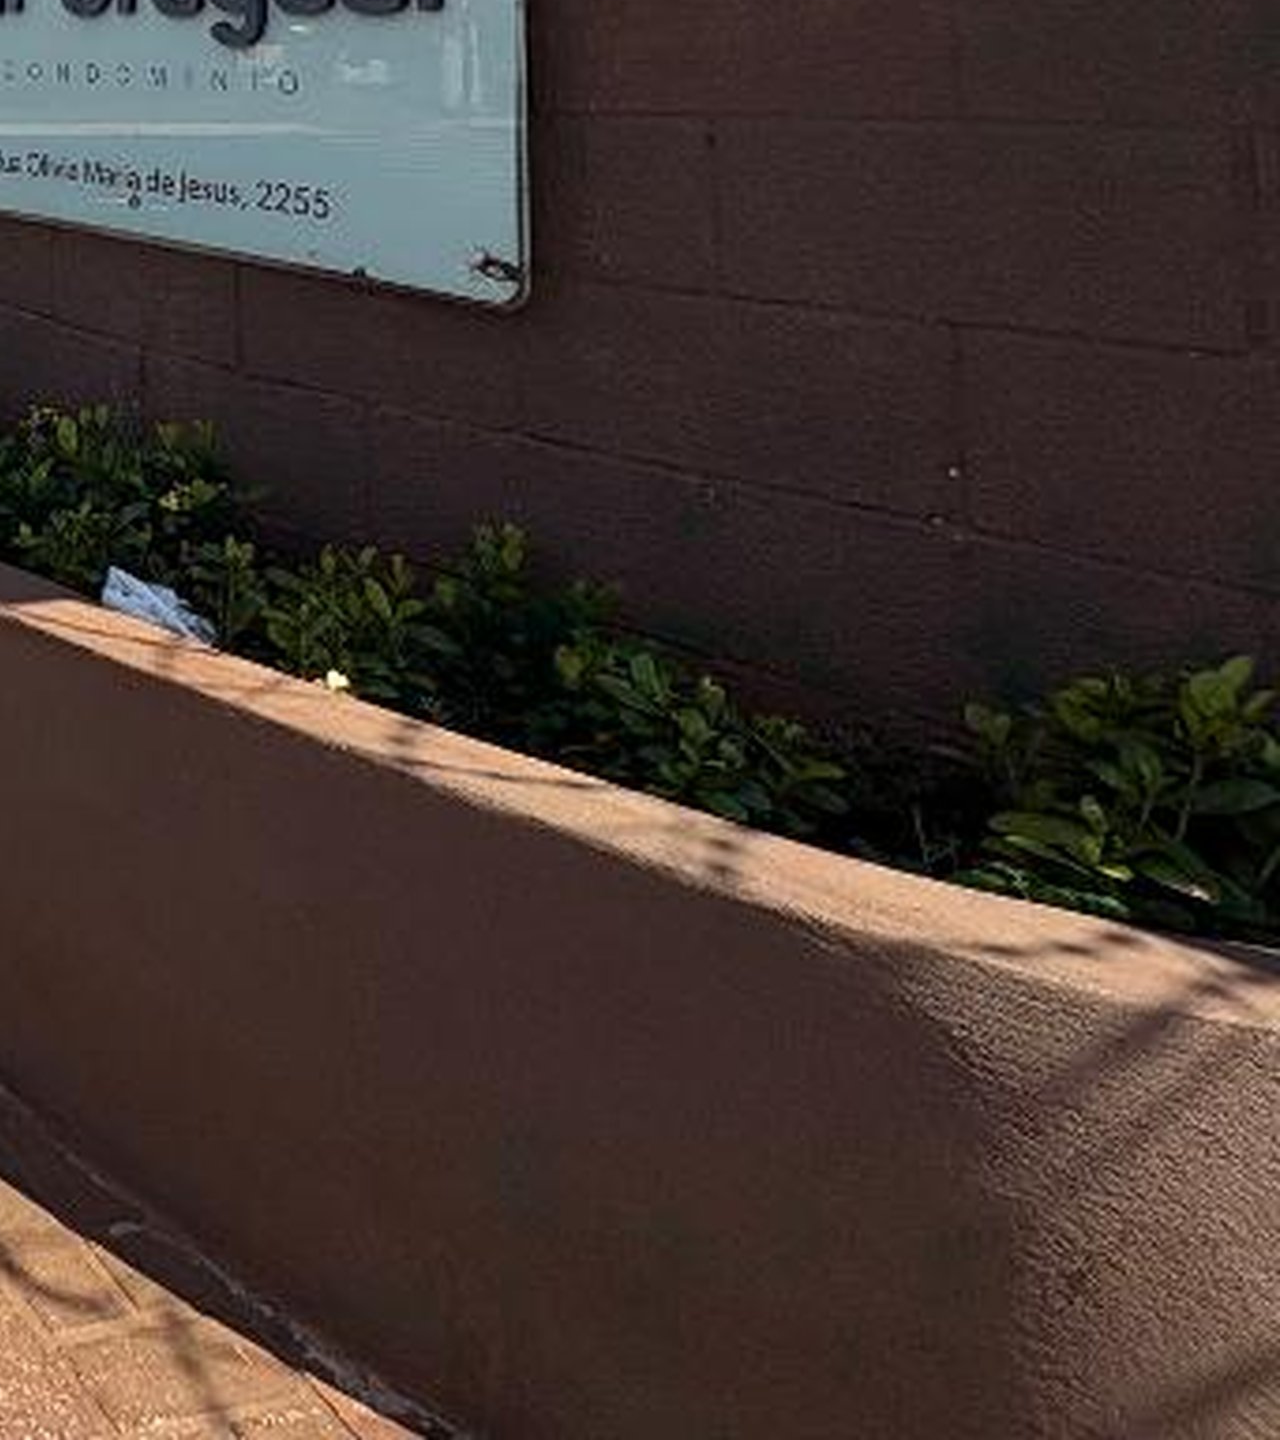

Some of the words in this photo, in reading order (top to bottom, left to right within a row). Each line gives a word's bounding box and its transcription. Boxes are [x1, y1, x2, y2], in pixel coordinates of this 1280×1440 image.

[147, 168, 175, 196] de
[178, 170, 248, 211] Jesus,
[255, 180, 331, 220] 2255
